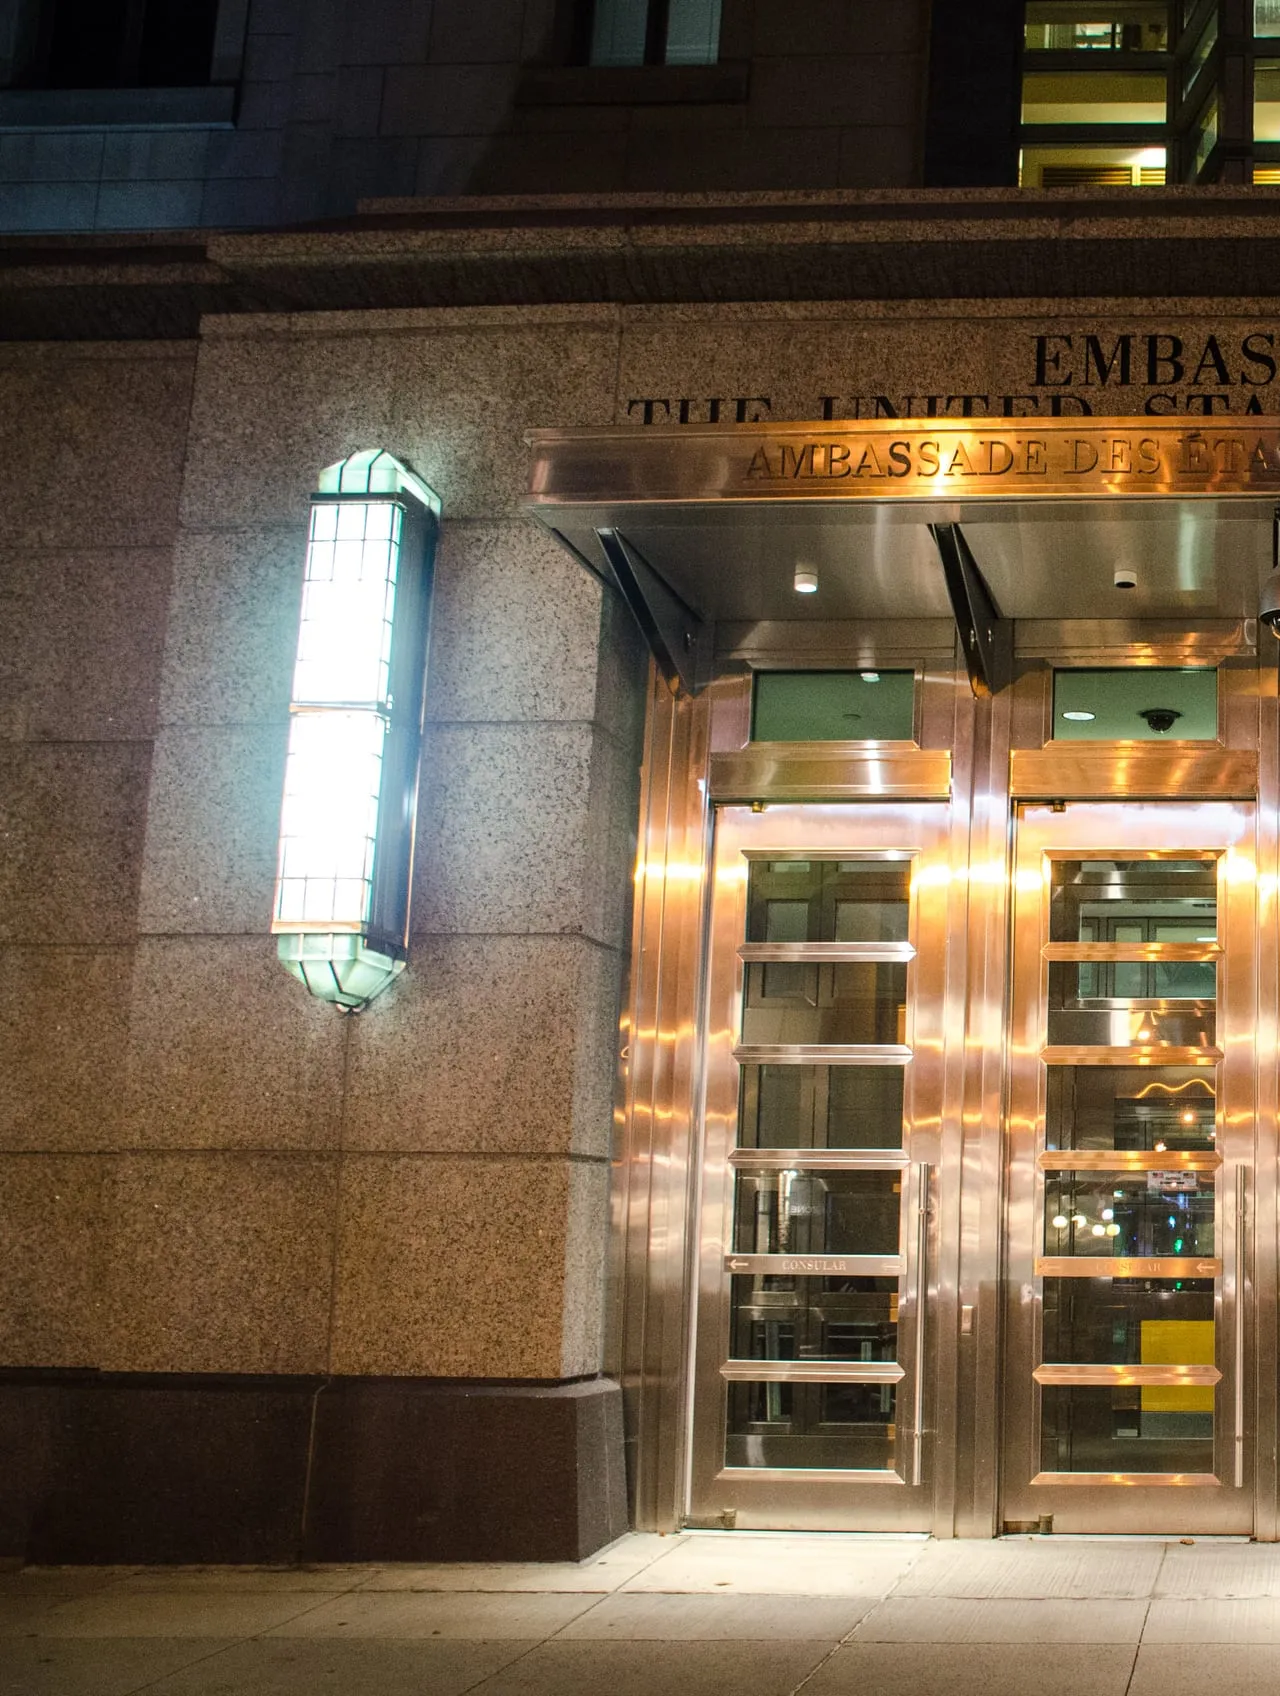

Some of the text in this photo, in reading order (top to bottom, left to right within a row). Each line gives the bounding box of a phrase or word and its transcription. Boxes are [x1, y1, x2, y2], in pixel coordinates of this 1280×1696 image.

[742, 438, 1048, 480] AMBASSADE
[1063, 438, 1162, 475] DES
[782, 1259, 847, 1271] CONSULAR
